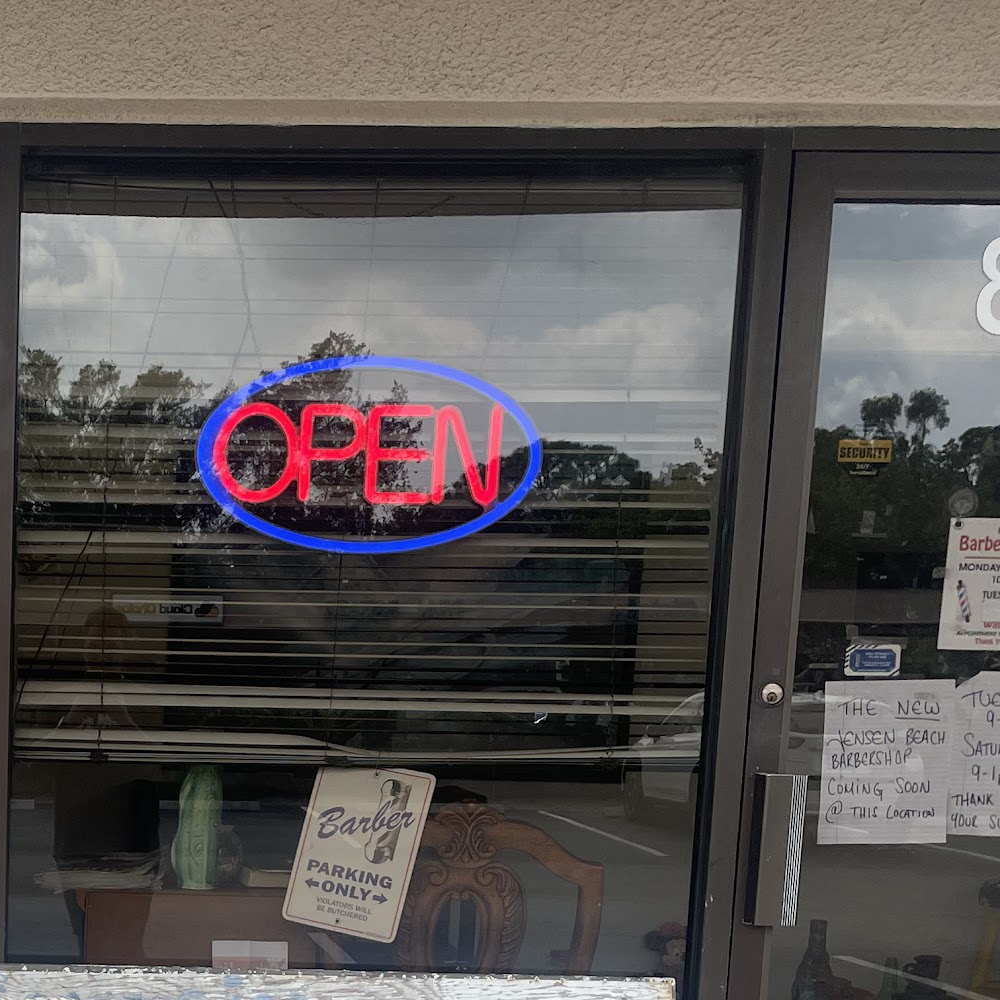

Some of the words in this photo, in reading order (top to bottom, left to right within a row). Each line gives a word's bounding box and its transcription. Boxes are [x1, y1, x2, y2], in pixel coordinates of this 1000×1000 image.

[212, 401, 504, 507] OPEN
[839, 447, 890, 458] SECURITY
[838, 697, 877, 716] THE
[897, 699, 940, 716] NEW
[827, 729, 896, 752] JENSEN
[906, 728, 946, 745] BEACH
[961, 732, 1000, 757] SATU
[831, 748, 912, 769] BARBERSHOP
[895, 777, 930, 794] SOON
[951, 792, 994, 807] THANK
[317, 801, 416, 839] Barber
[825, 800, 843, 823] @
[850, 806, 878, 820] THIS
[886, 805, 935, 820] LOCATION
[306, 859, 393, 890] PARKING
[321, 880, 373, 902] ONLY
[316, 896, 354, 911] VIOLATORS
[355, 905, 372, 914] WILL
[316, 904, 326, 912] BE
[327, 907, 368, 921] BUTCHERED
